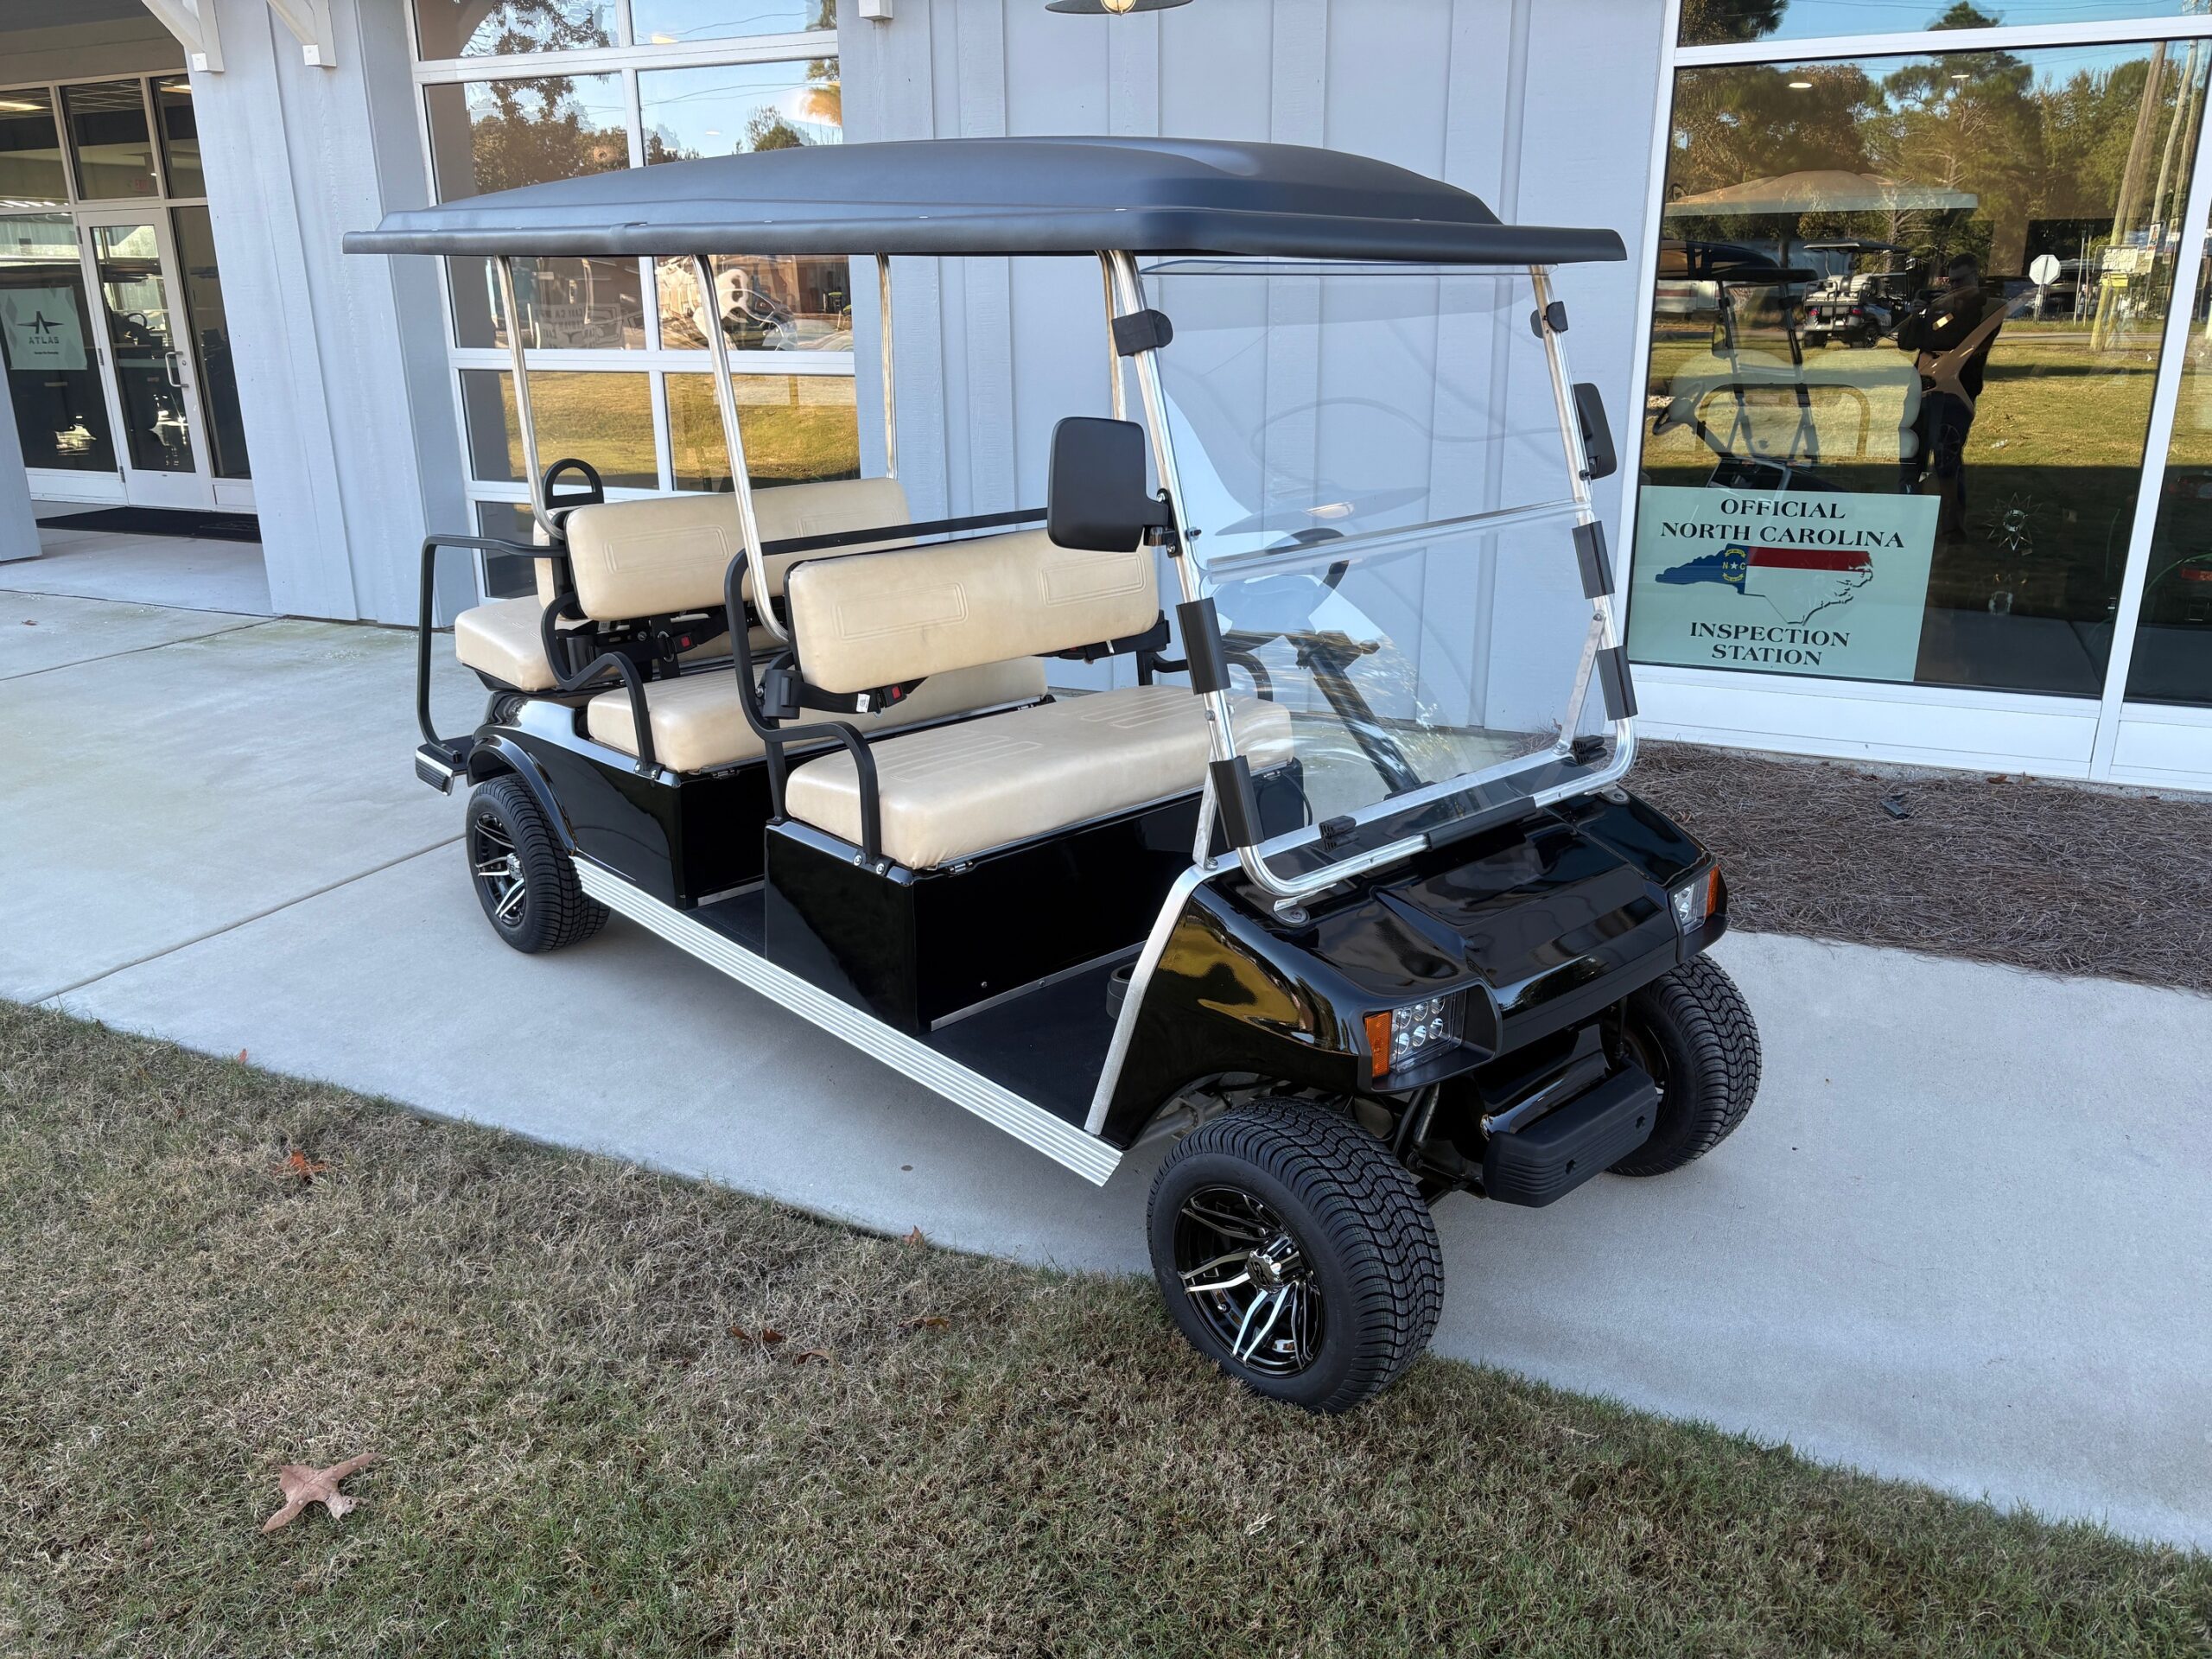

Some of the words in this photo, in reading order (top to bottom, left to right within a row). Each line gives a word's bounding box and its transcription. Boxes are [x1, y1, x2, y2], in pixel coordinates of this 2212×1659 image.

[29, 336, 60, 345] ATLAS
[1720, 499, 1846, 518] OFFICIAL
[1660, 522, 1751, 541] NORTH
[1759, 526, 1904, 548] CAROLINA
[1739, 562, 1746, 570] C
[1690, 622, 1850, 647] INSPECTION
[1712, 644, 1822, 665] STATION
